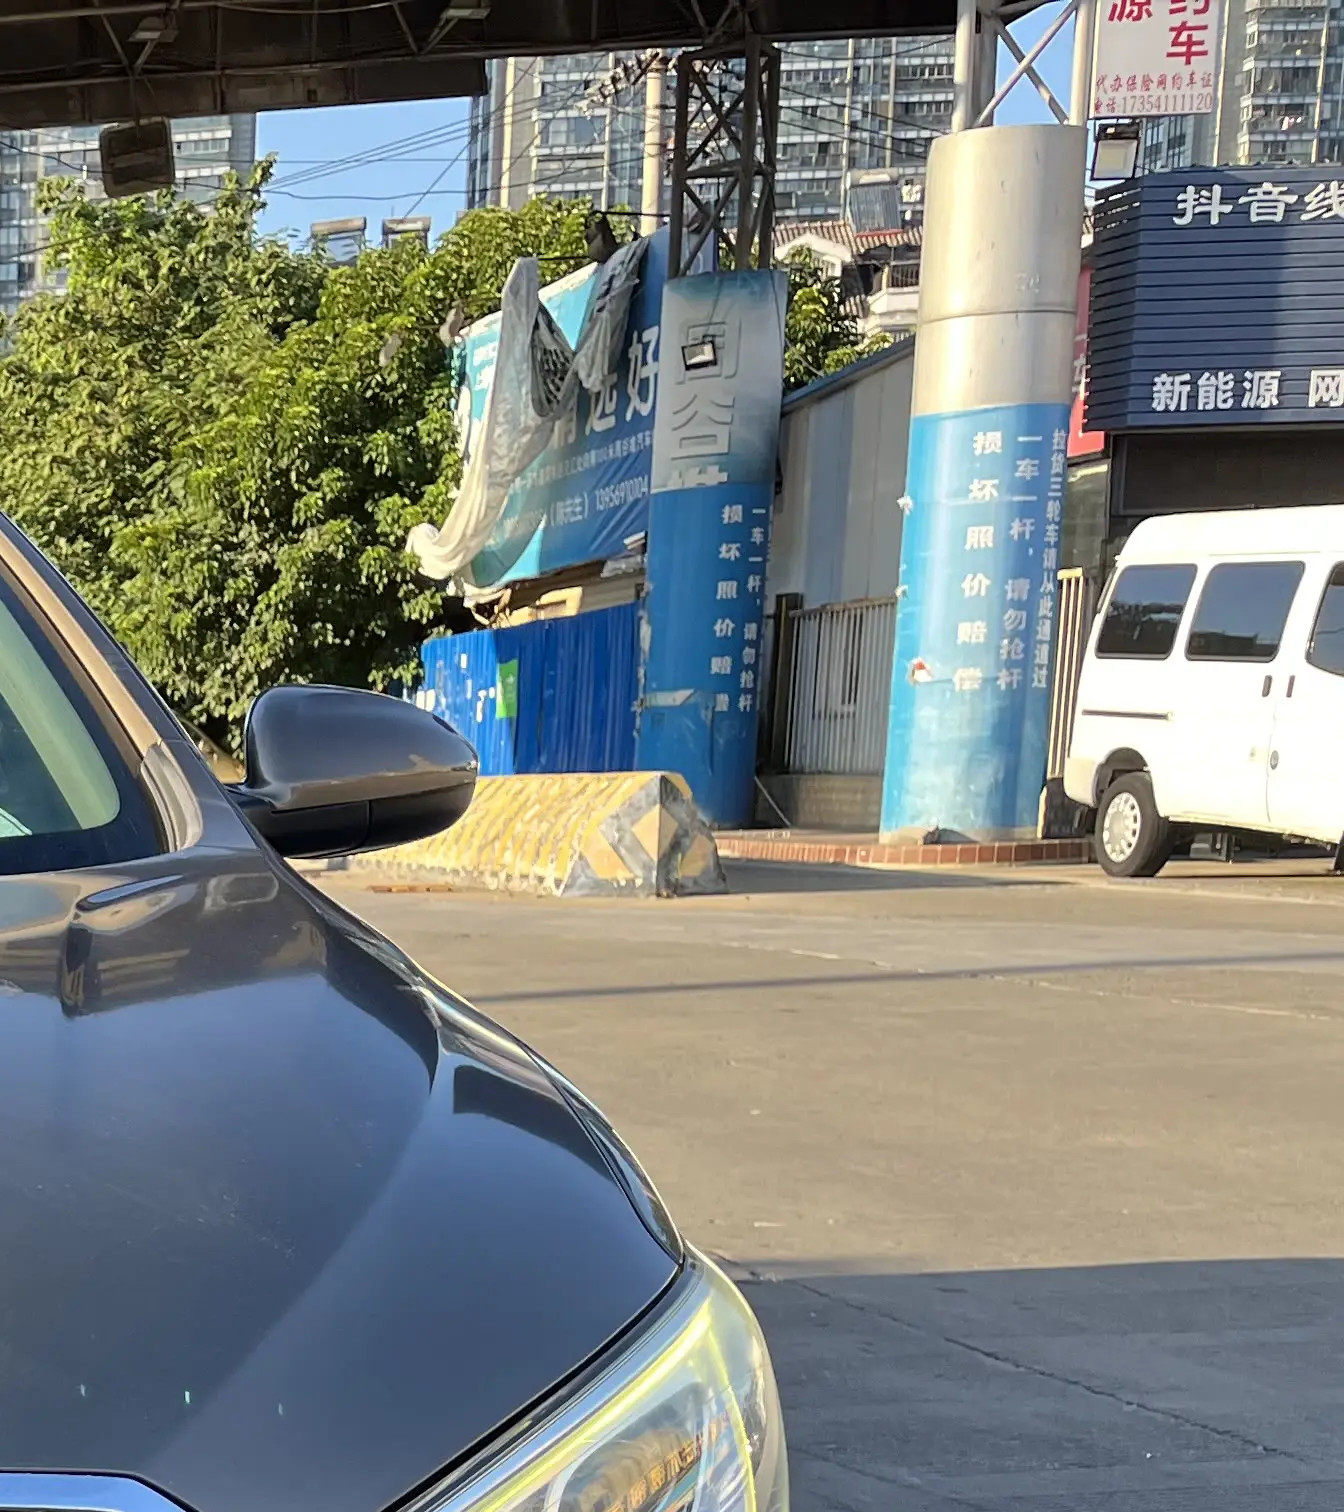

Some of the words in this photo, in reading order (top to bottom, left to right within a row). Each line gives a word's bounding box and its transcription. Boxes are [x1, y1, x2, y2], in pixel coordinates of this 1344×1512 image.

[1150, 370, 1282, 412] 新能源
[1308, 369, 1344, 409] 网
[952, 430, 1003, 692] 损坏照价赔偿
